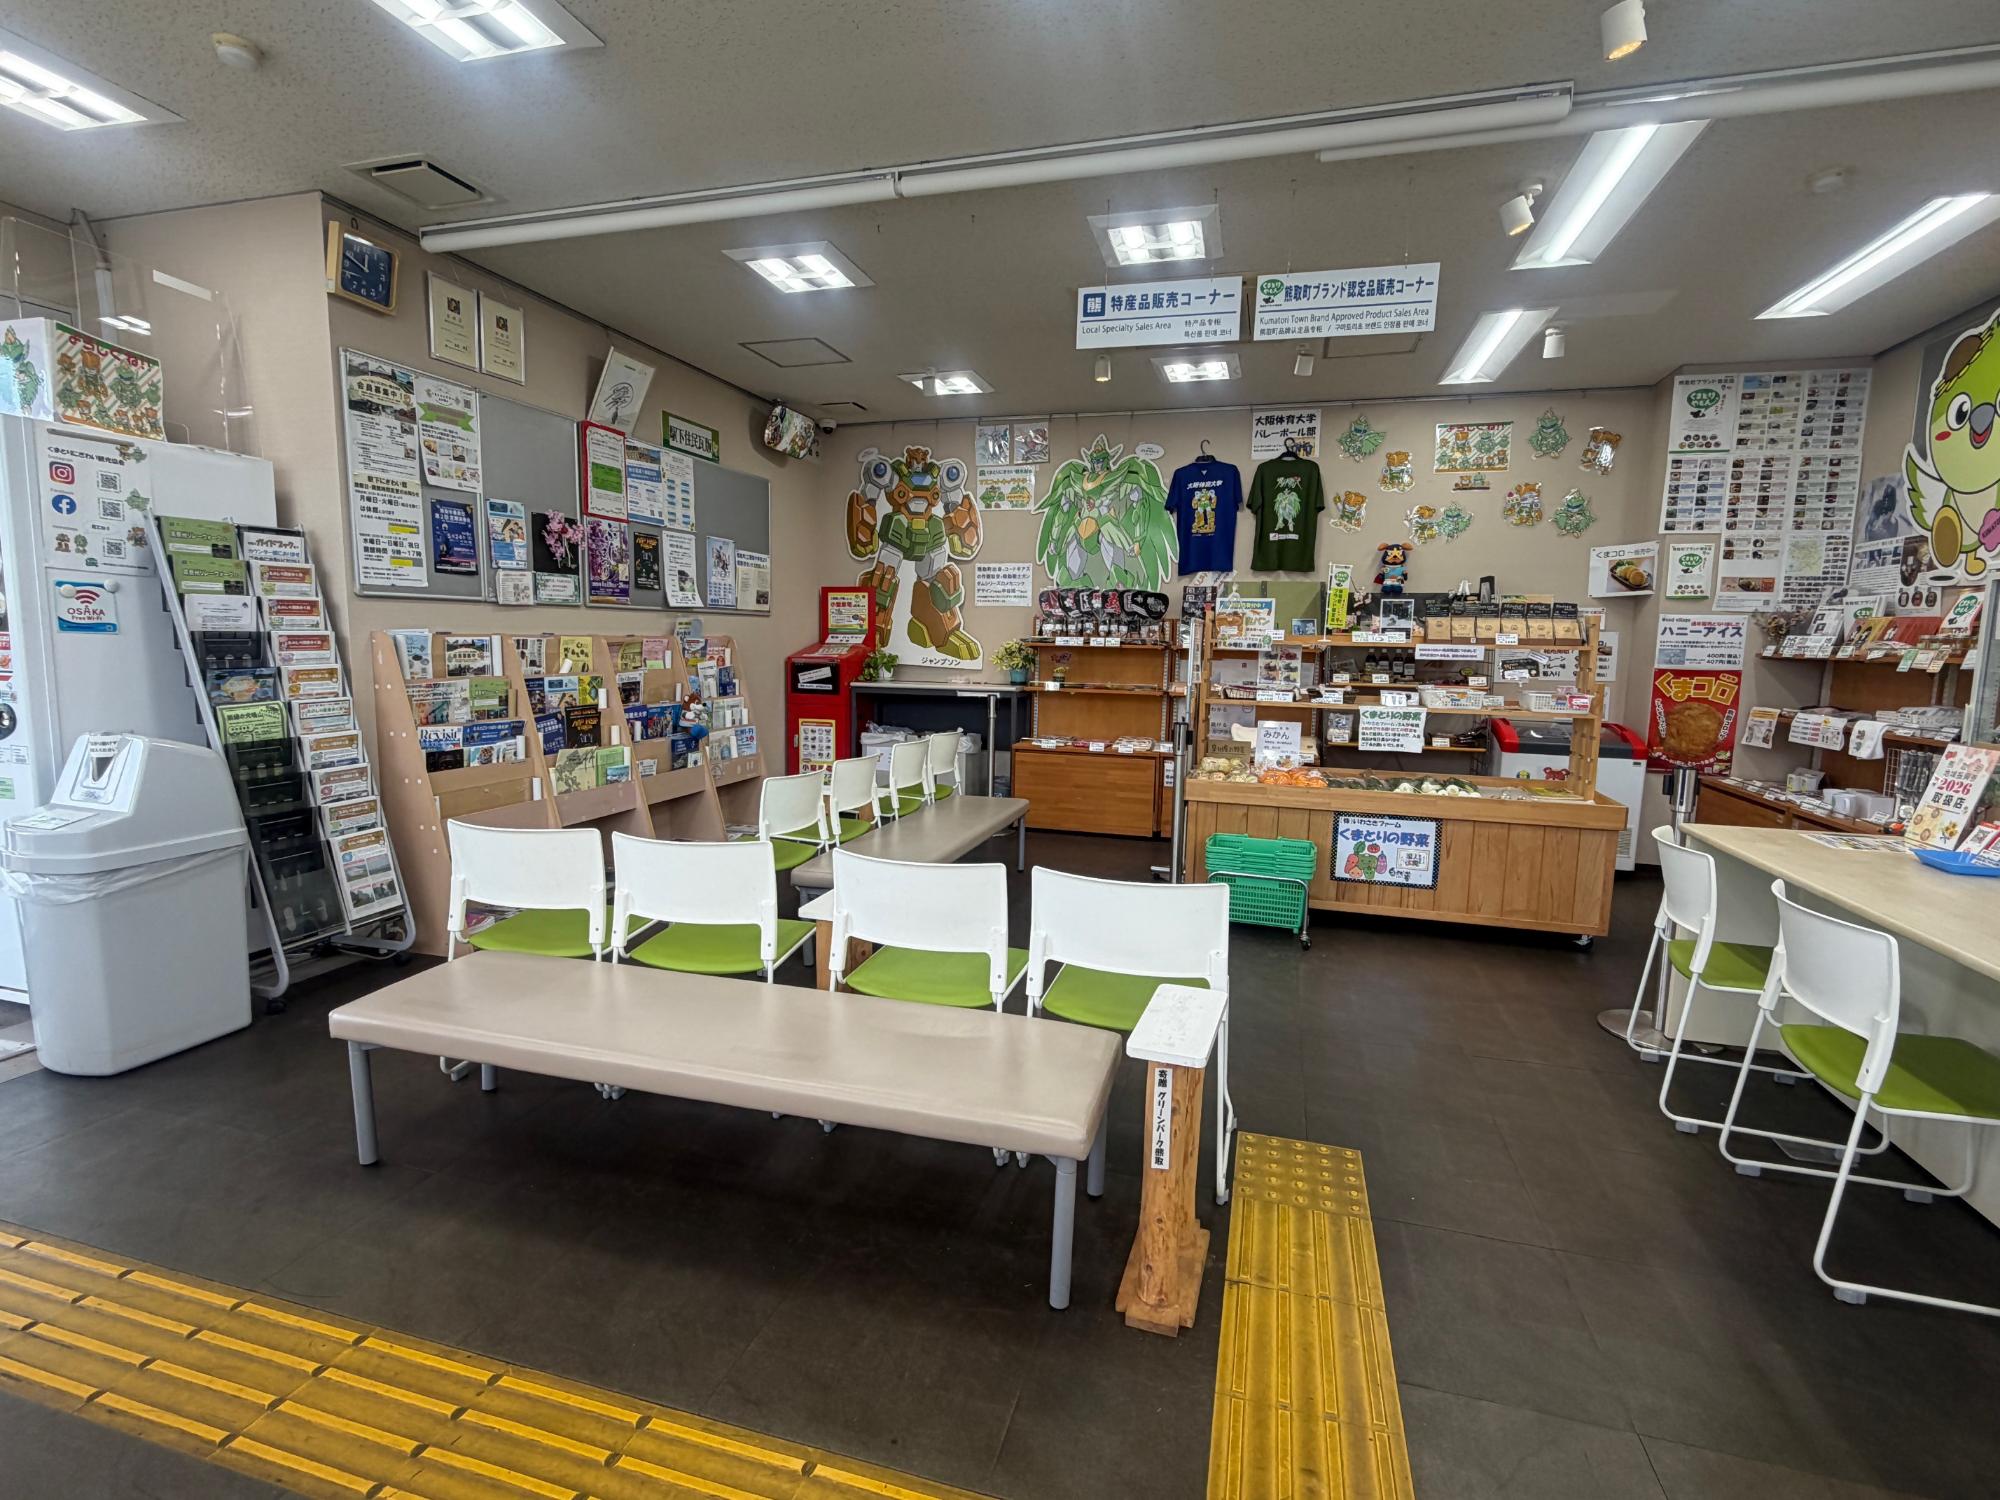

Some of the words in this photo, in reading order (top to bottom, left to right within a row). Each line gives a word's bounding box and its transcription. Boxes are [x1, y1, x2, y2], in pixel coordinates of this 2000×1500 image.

[1284, 276, 1434, 302] 熊取町ブランド認定品販売コーナー
[1087, 297, 1102, 313] 熊
[1110, 289, 1235, 312] 特産品販売コーナー
[1184, 318, 1221, 328] 特产品专柜
[1260, 317, 1289, 325] Kumatori
[1291, 315, 1308, 323] Town
[1310, 313, 1329, 322] Brand
[1331, 311, 1364, 322] Approved
[1366, 310, 1392, 320] Product
[1394, 309, 1411, 317] Sales
[1413, 308, 1429, 316] Area
[1082, 324, 1100, 334] Local
[1102, 323, 1133, 335] Specialty
[1135, 322, 1153, 331] Sales
[1155, 321, 1172, 330] Area
[1255, 413, 1316, 426] 大阪体育大学
[669, 425, 712, 453] 駅下住民瓦版
[1255, 427, 1316, 438] バレーボール部
[1187, 480, 1223, 489] 大阪体育大学
[1596, 550, 1625, 558] くまコロ
[67, 608, 105, 616] OSAKA
[1661, 627, 1743, 638] ハニーアイス
[921, 656, 960, 666] ジャンプソン
[1655, 671, 1738, 705] くまコロ
[1361, 710, 1422, 721] くまとりの野菜
[1263, 730, 1290, 739] みかん
[1937, 778, 1972, 796] 2026
[1931, 792, 1966, 809] 取扱店
[1339, 828, 1430, 847] くまとりの野菜
[1158, 1070, 1168, 1087] 寄贈
[1154, 1091, 1167, 1166] グリーンパーク熊取
